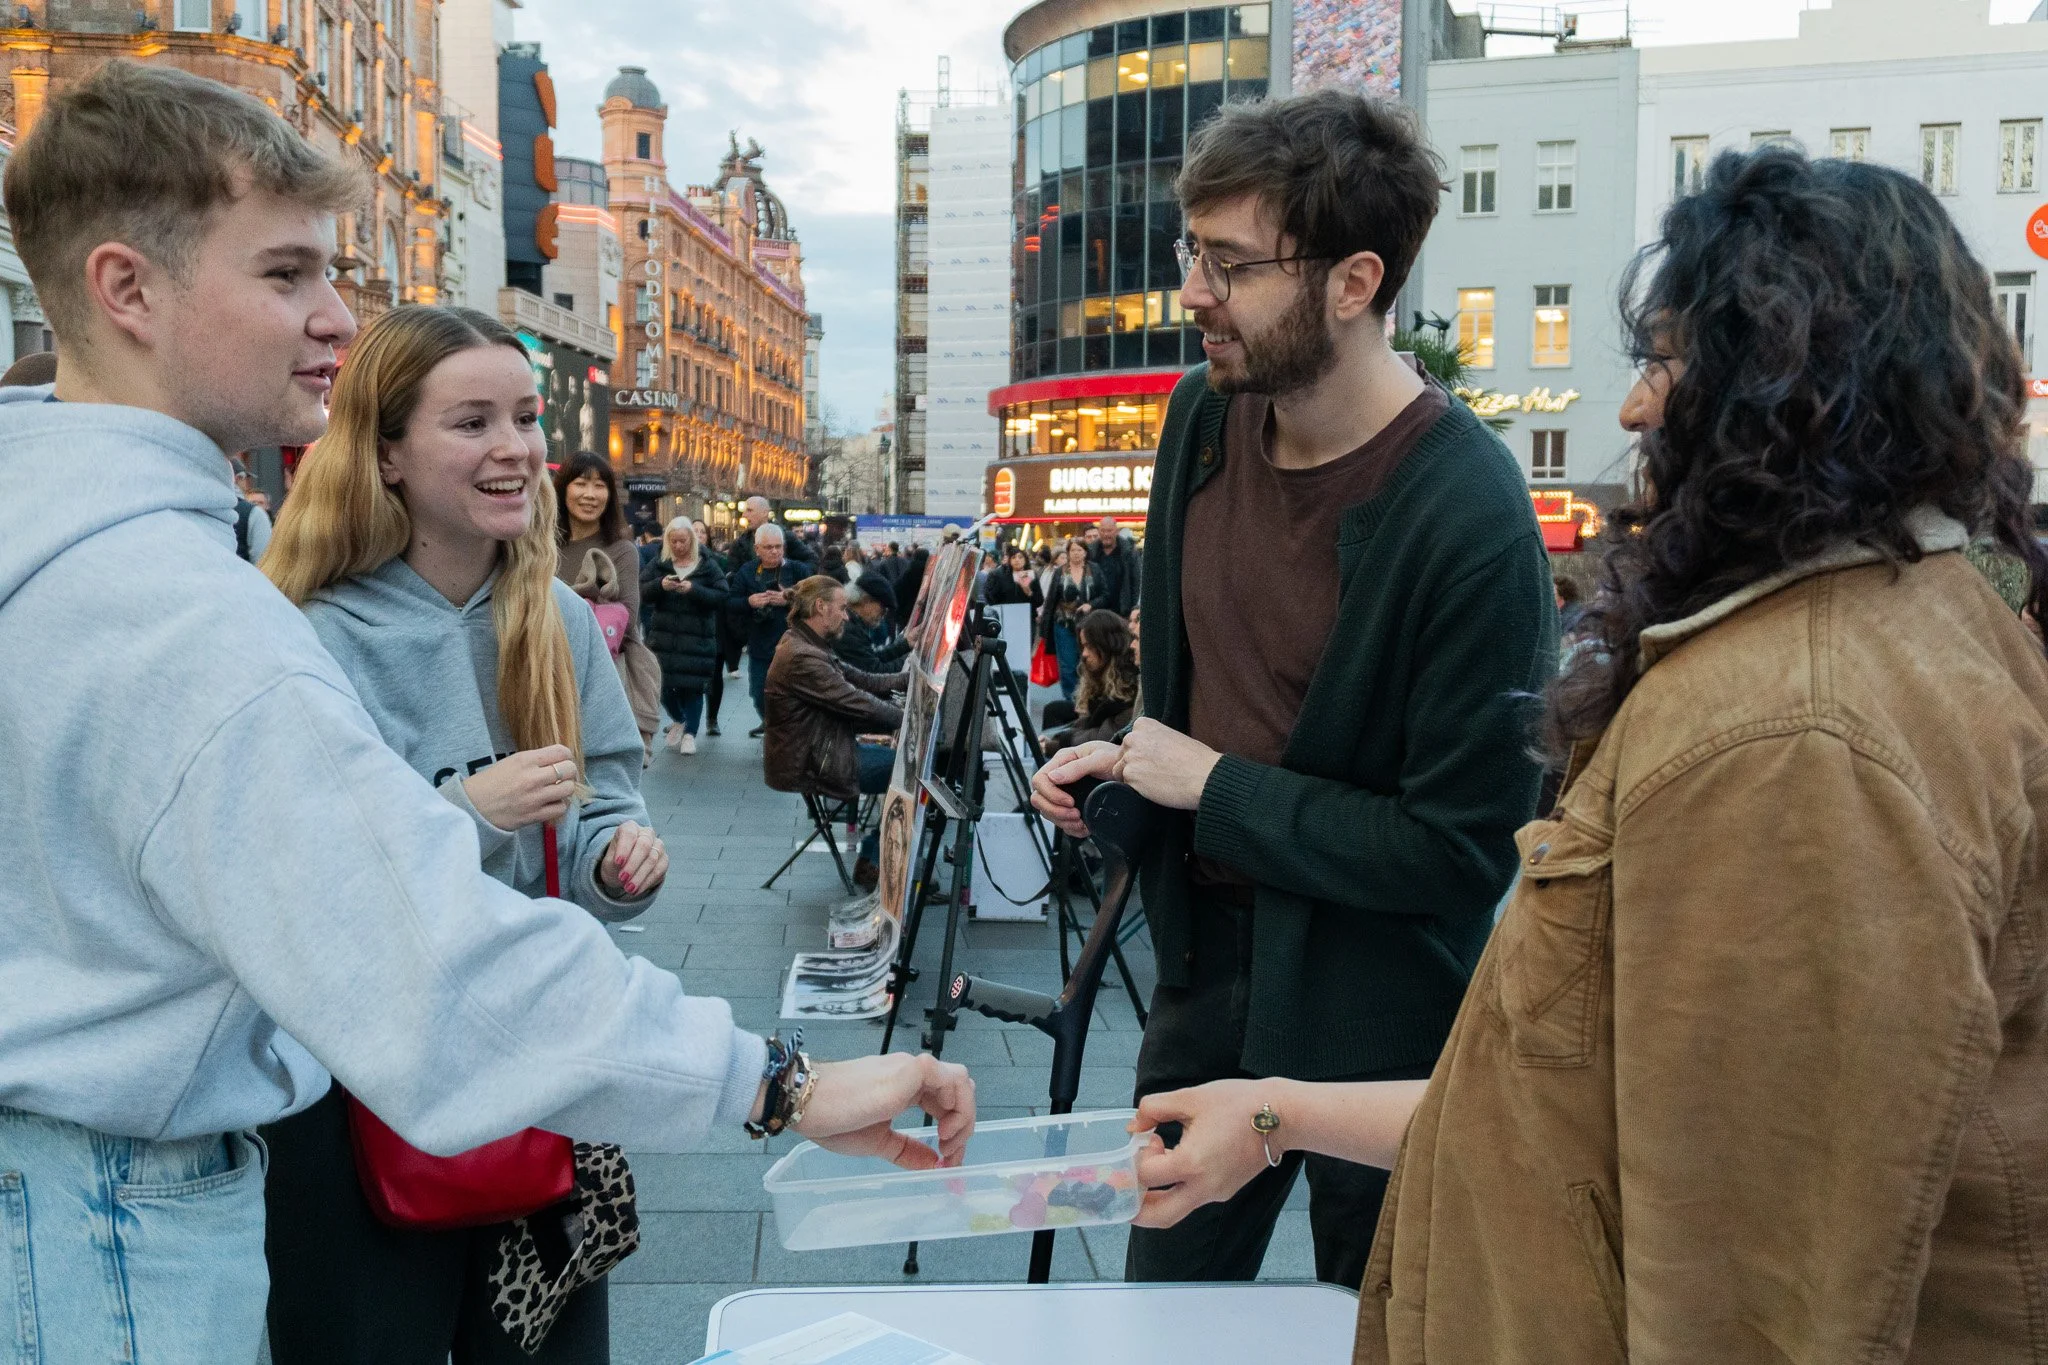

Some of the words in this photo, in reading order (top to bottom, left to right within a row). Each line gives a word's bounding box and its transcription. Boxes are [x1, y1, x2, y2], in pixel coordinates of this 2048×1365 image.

[644, 175, 662, 379] HIPPODROME
[614, 389, 678, 408] CASINO
[1521, 386, 1580, 414] Hut
[1049, 466, 1132, 493] BURGER
[1133, 465, 1153, 491] K
